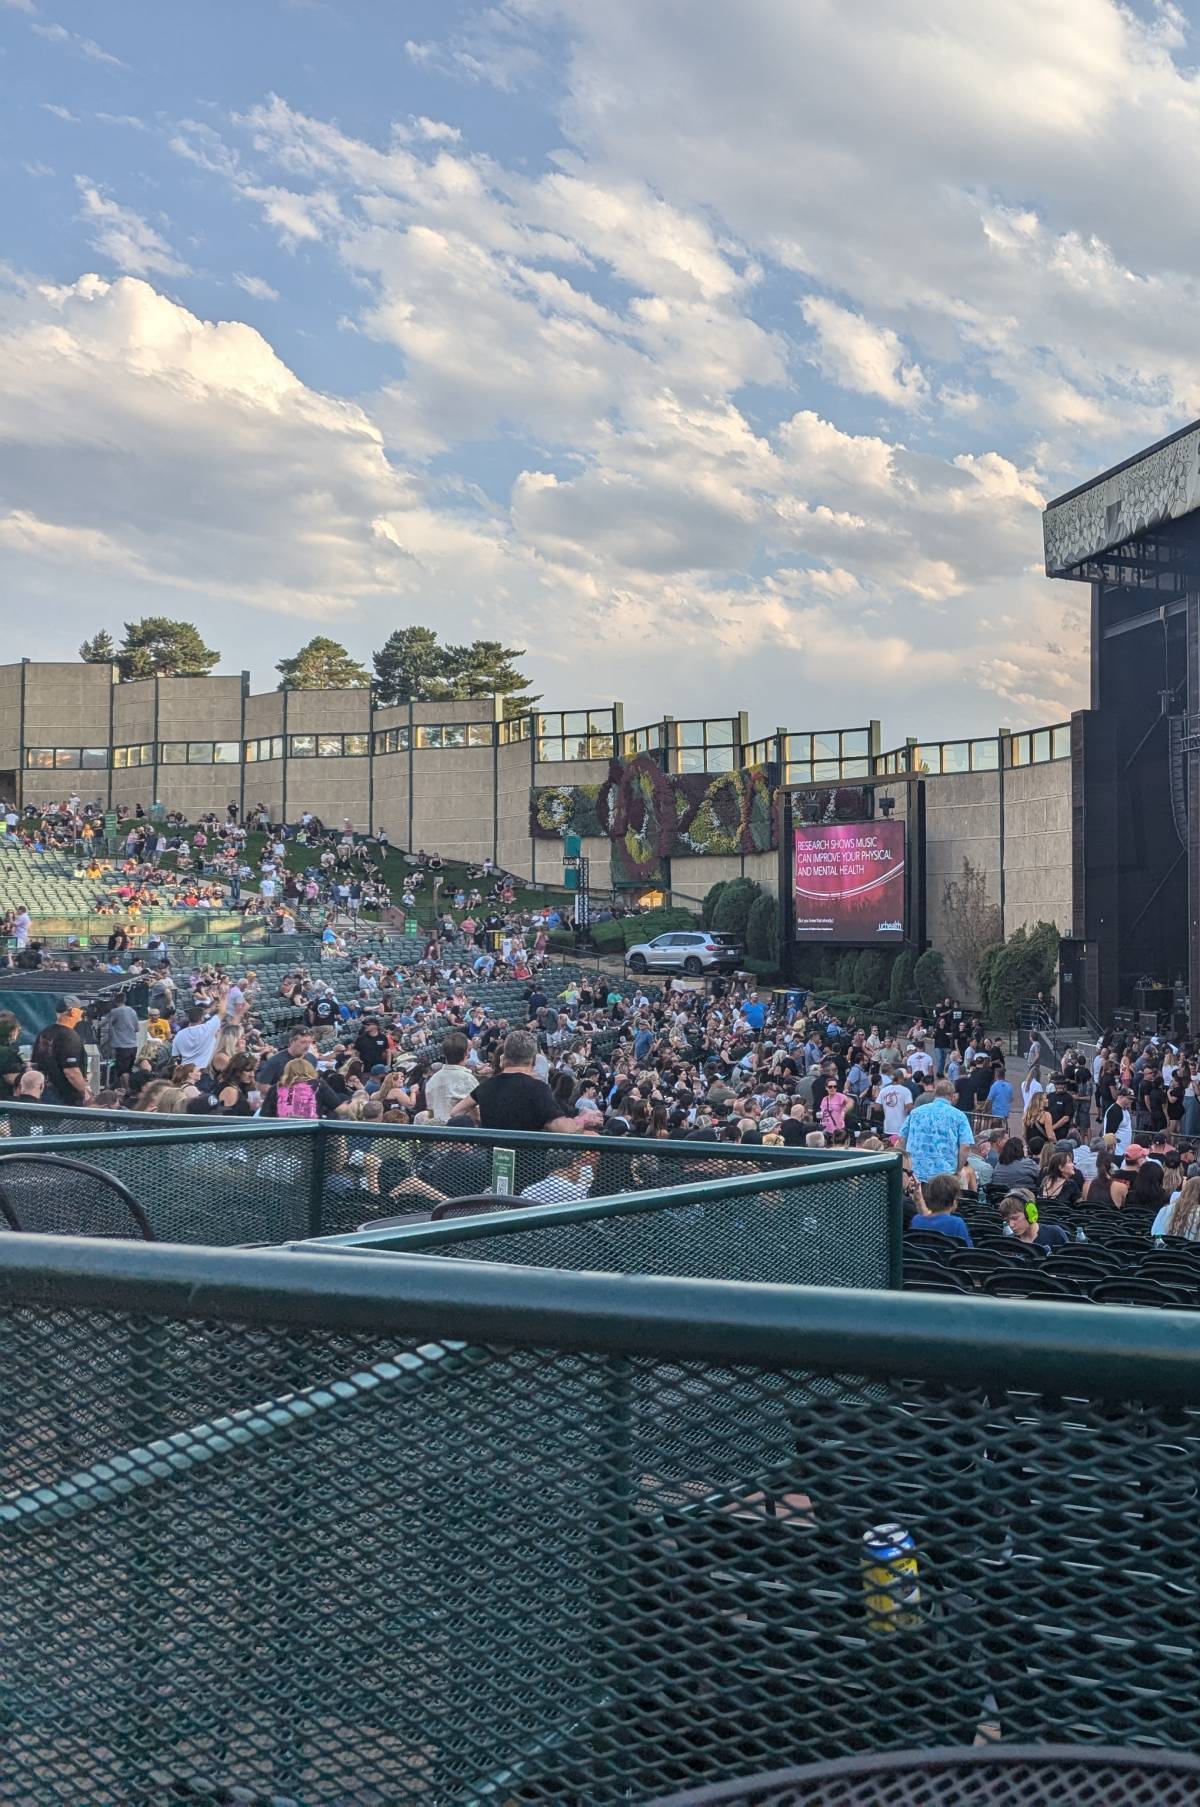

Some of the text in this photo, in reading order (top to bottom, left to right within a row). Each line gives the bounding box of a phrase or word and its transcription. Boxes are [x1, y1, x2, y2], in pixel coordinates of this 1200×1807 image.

[797, 836, 878, 851] RESEARCH SHOWS MUSIC
[797, 849, 893, 864] CAN IMPROVE YOUR PHYSICAL
[797, 864, 865, 876] AND MENTAL HEALTH
